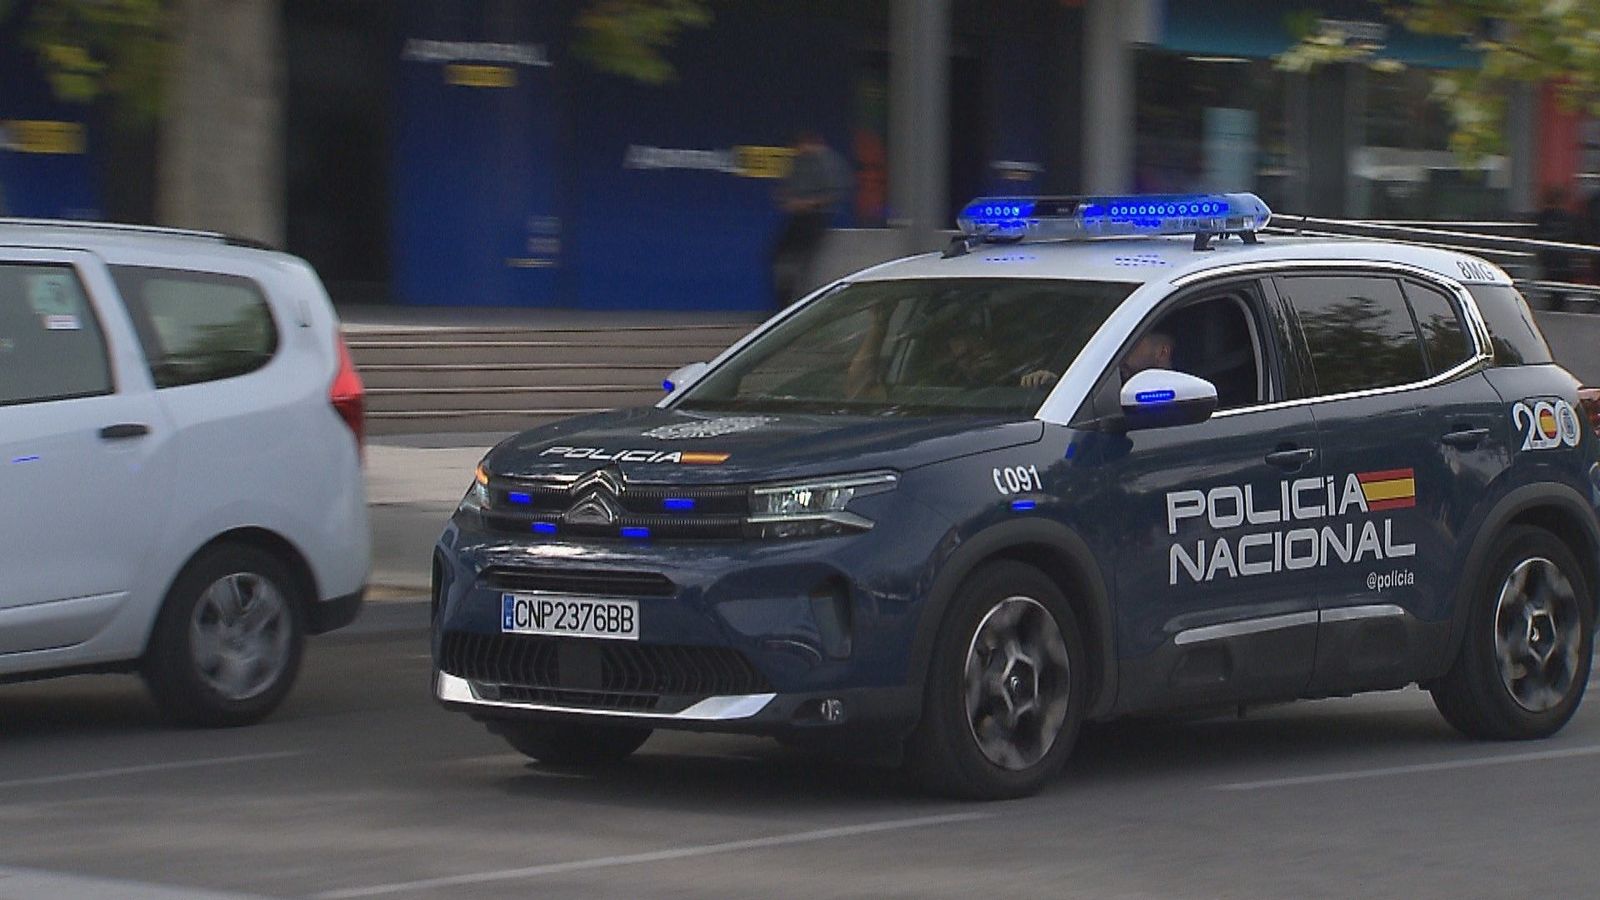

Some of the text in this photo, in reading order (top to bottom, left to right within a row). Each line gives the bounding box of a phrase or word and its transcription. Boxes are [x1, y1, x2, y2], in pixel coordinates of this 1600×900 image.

[1456, 261, 1496, 281] 8MG
[539, 446, 682, 464] POLICIA
[993, 464, 1043, 495] C091
[1169, 518, 1417, 585] NACIONAL
[1366, 568, 1415, 593] @policia
[515, 599, 634, 633] CNP2376BB
